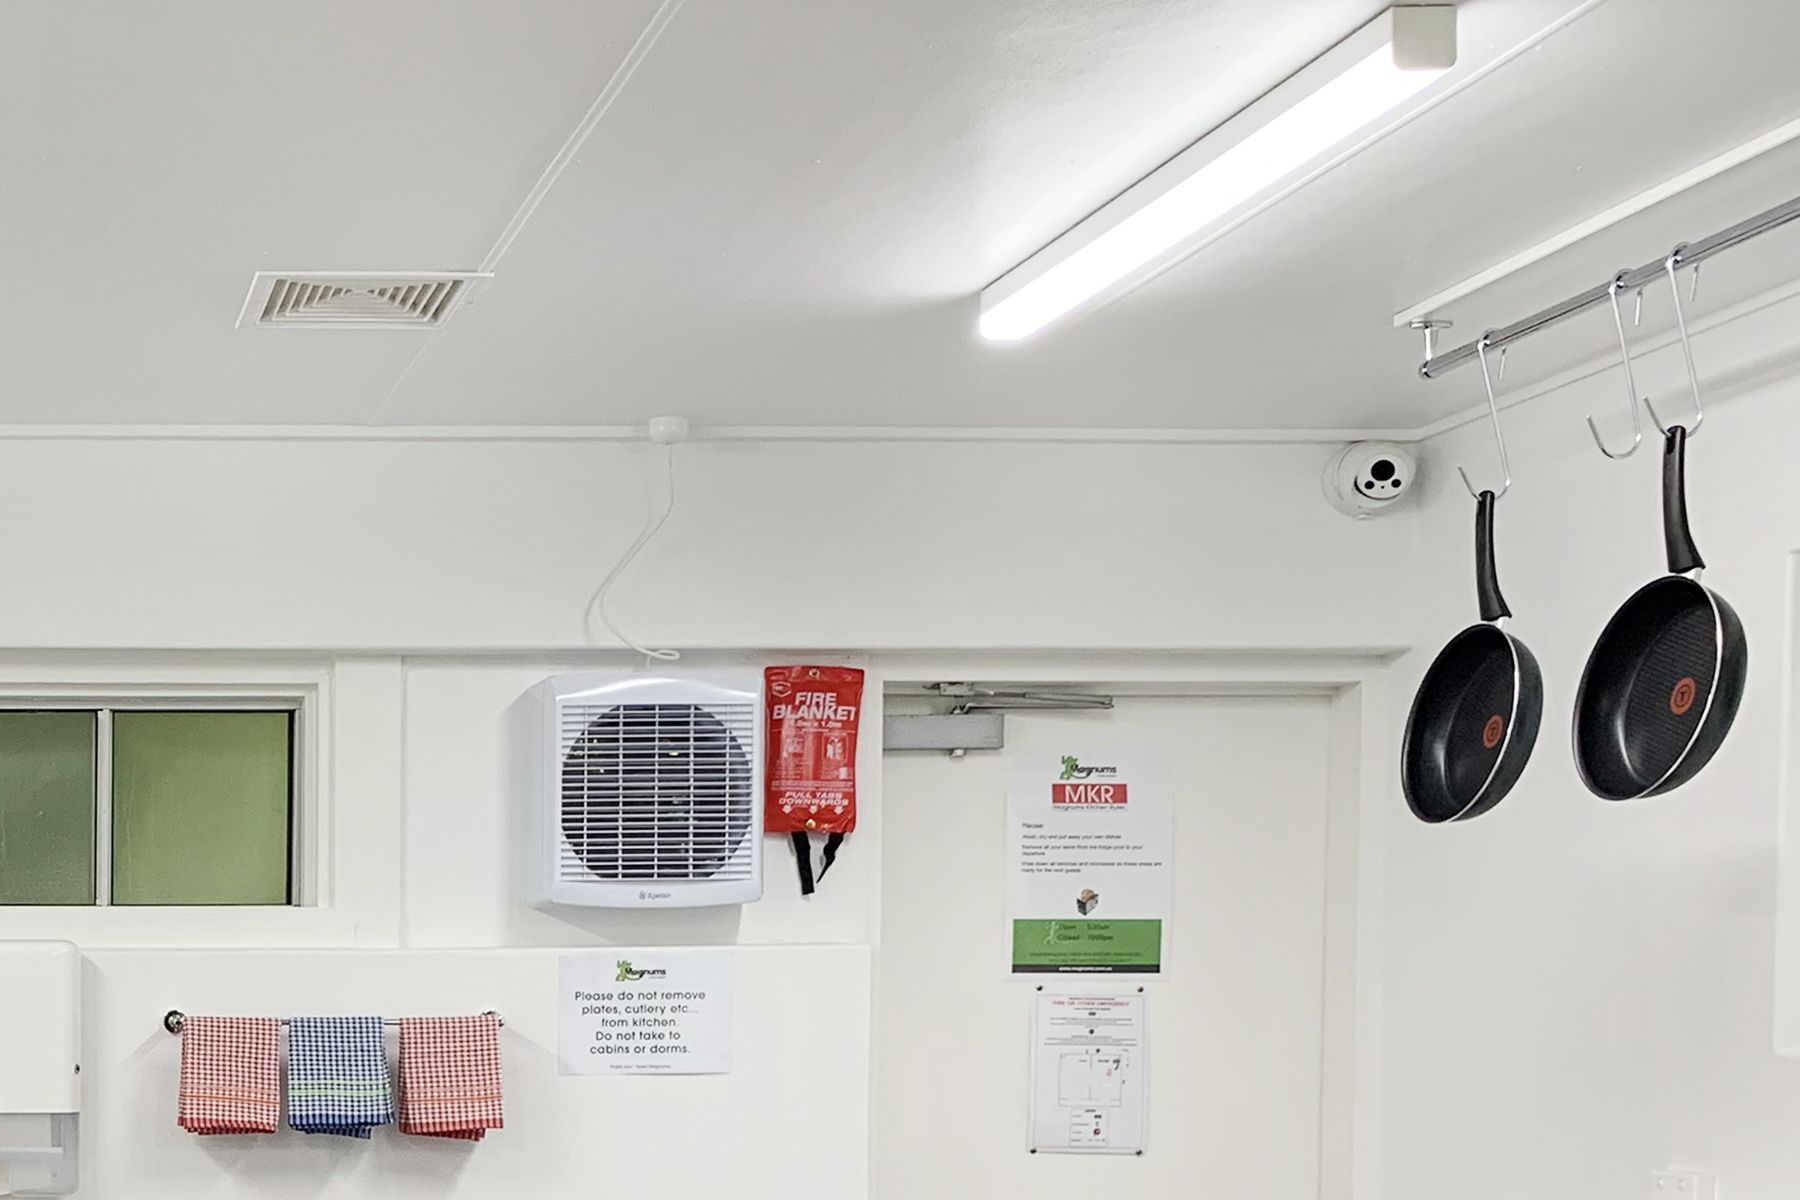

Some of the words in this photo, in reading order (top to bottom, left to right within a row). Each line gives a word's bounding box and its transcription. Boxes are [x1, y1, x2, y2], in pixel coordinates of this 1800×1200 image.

[795, 692, 837, 705] FIRE
[773, 704, 856, 721] BLANKET
[1065, 785, 1114, 803] MKR
[778, 798, 849, 806] DOWNWARDS
[575, 991, 614, 1001] Please
[617, 991, 634, 1001] do
[637, 991, 658, 1001] not
[661, 992, 706, 1001] remove
[582, 1004, 622, 1016] plates,
[624, 1004, 666, 1016] cutlery
[601, 1018, 629, 1028] from
[632, 1017, 680, 1028] kitchen.
[595, 1031, 613, 1041] Do
[616, 1031, 637, 1041] not
[639, 1030, 666, 1041] take
[669, 1031, 681, 1041] to
[590, 1045, 630, 1055] cabins
[634, 1047, 646, 1055] or
[650, 1044, 691, 1055] dorms.
